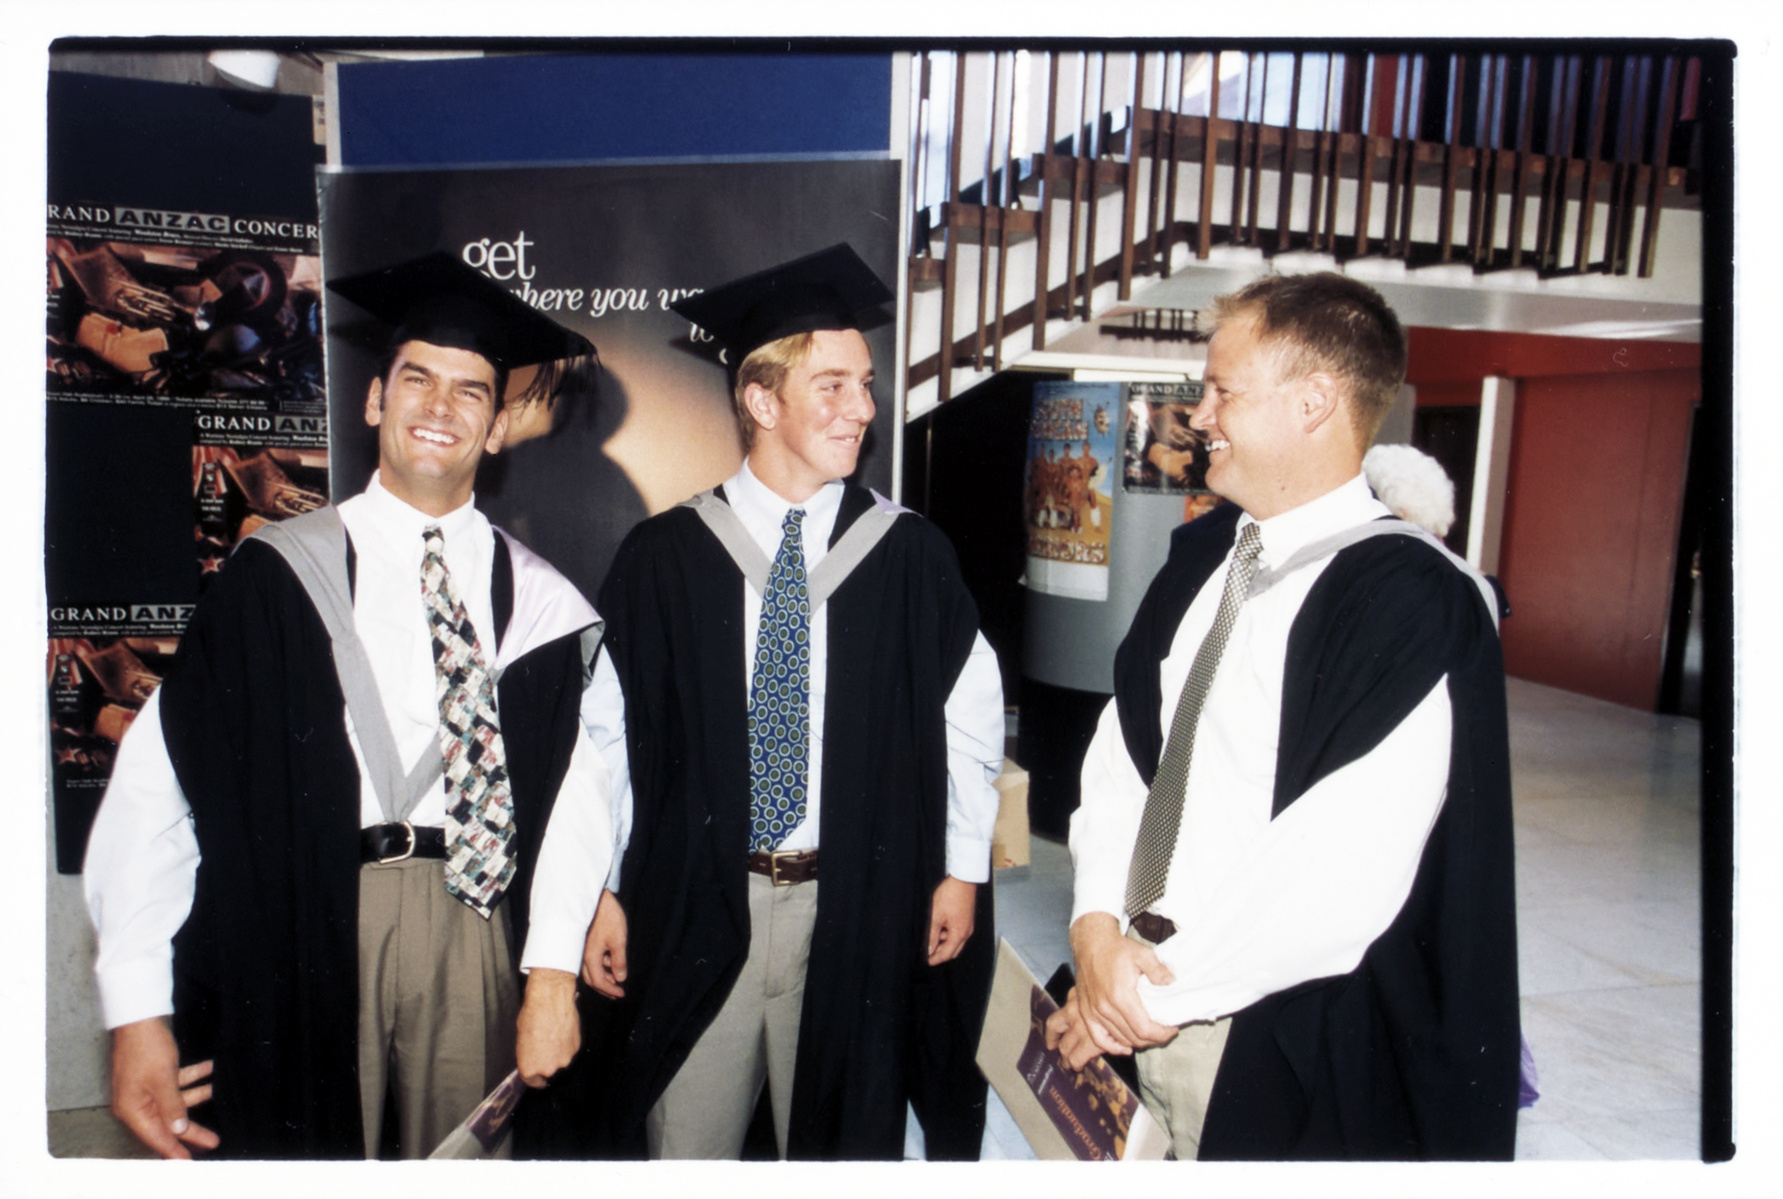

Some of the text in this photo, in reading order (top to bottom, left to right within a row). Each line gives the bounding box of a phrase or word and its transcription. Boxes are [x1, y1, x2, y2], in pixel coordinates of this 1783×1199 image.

[47, 204, 319, 239] RAND ANZAC CONCER
[509, 282, 584, 311] here
[590, 288, 650, 318] you
[197, 414, 271, 431] GRAND
[50, 606, 195, 621] GRAND ANZ
[1048, 1085, 1101, 1160] Graduation
